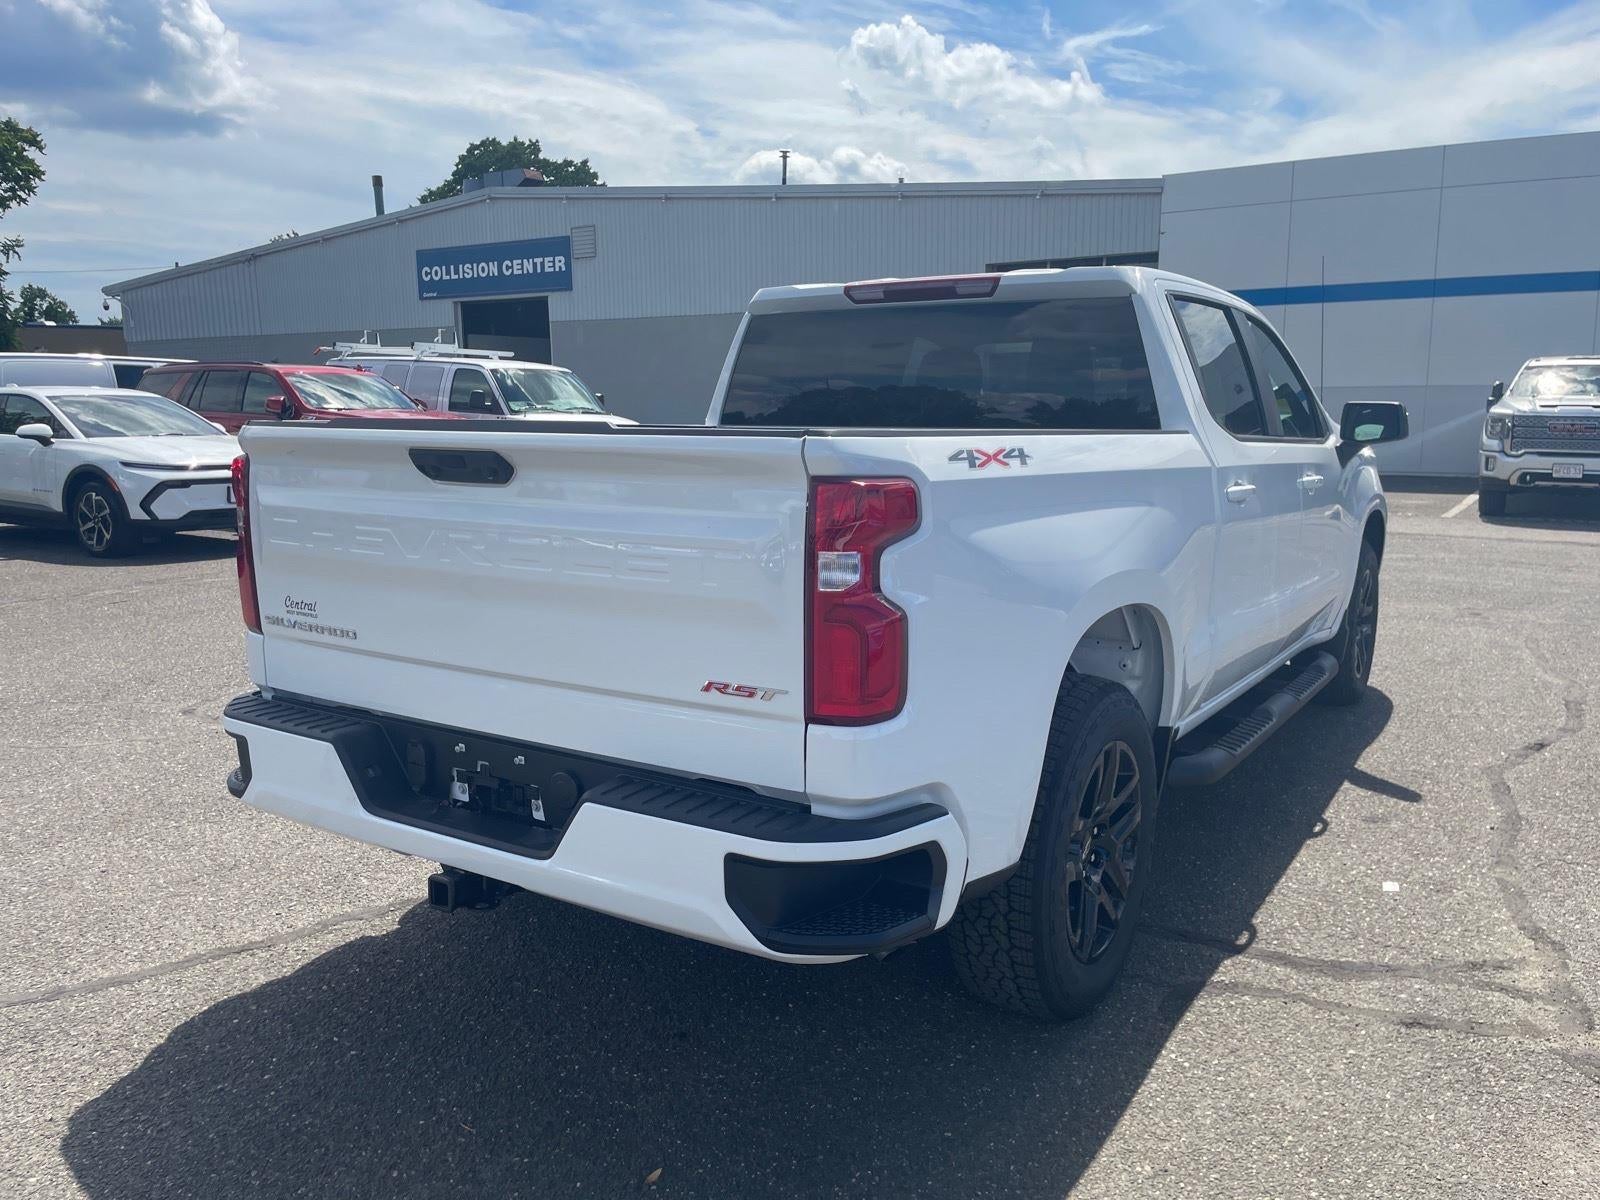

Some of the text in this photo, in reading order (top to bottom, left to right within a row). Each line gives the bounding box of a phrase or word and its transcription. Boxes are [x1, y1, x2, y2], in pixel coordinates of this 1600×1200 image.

[421, 255, 566, 282] COLLISION CENTER
[284, 595, 317, 612] Central
[265, 615, 357, 639] SILVERADO
[700, 679, 789, 701] RST
